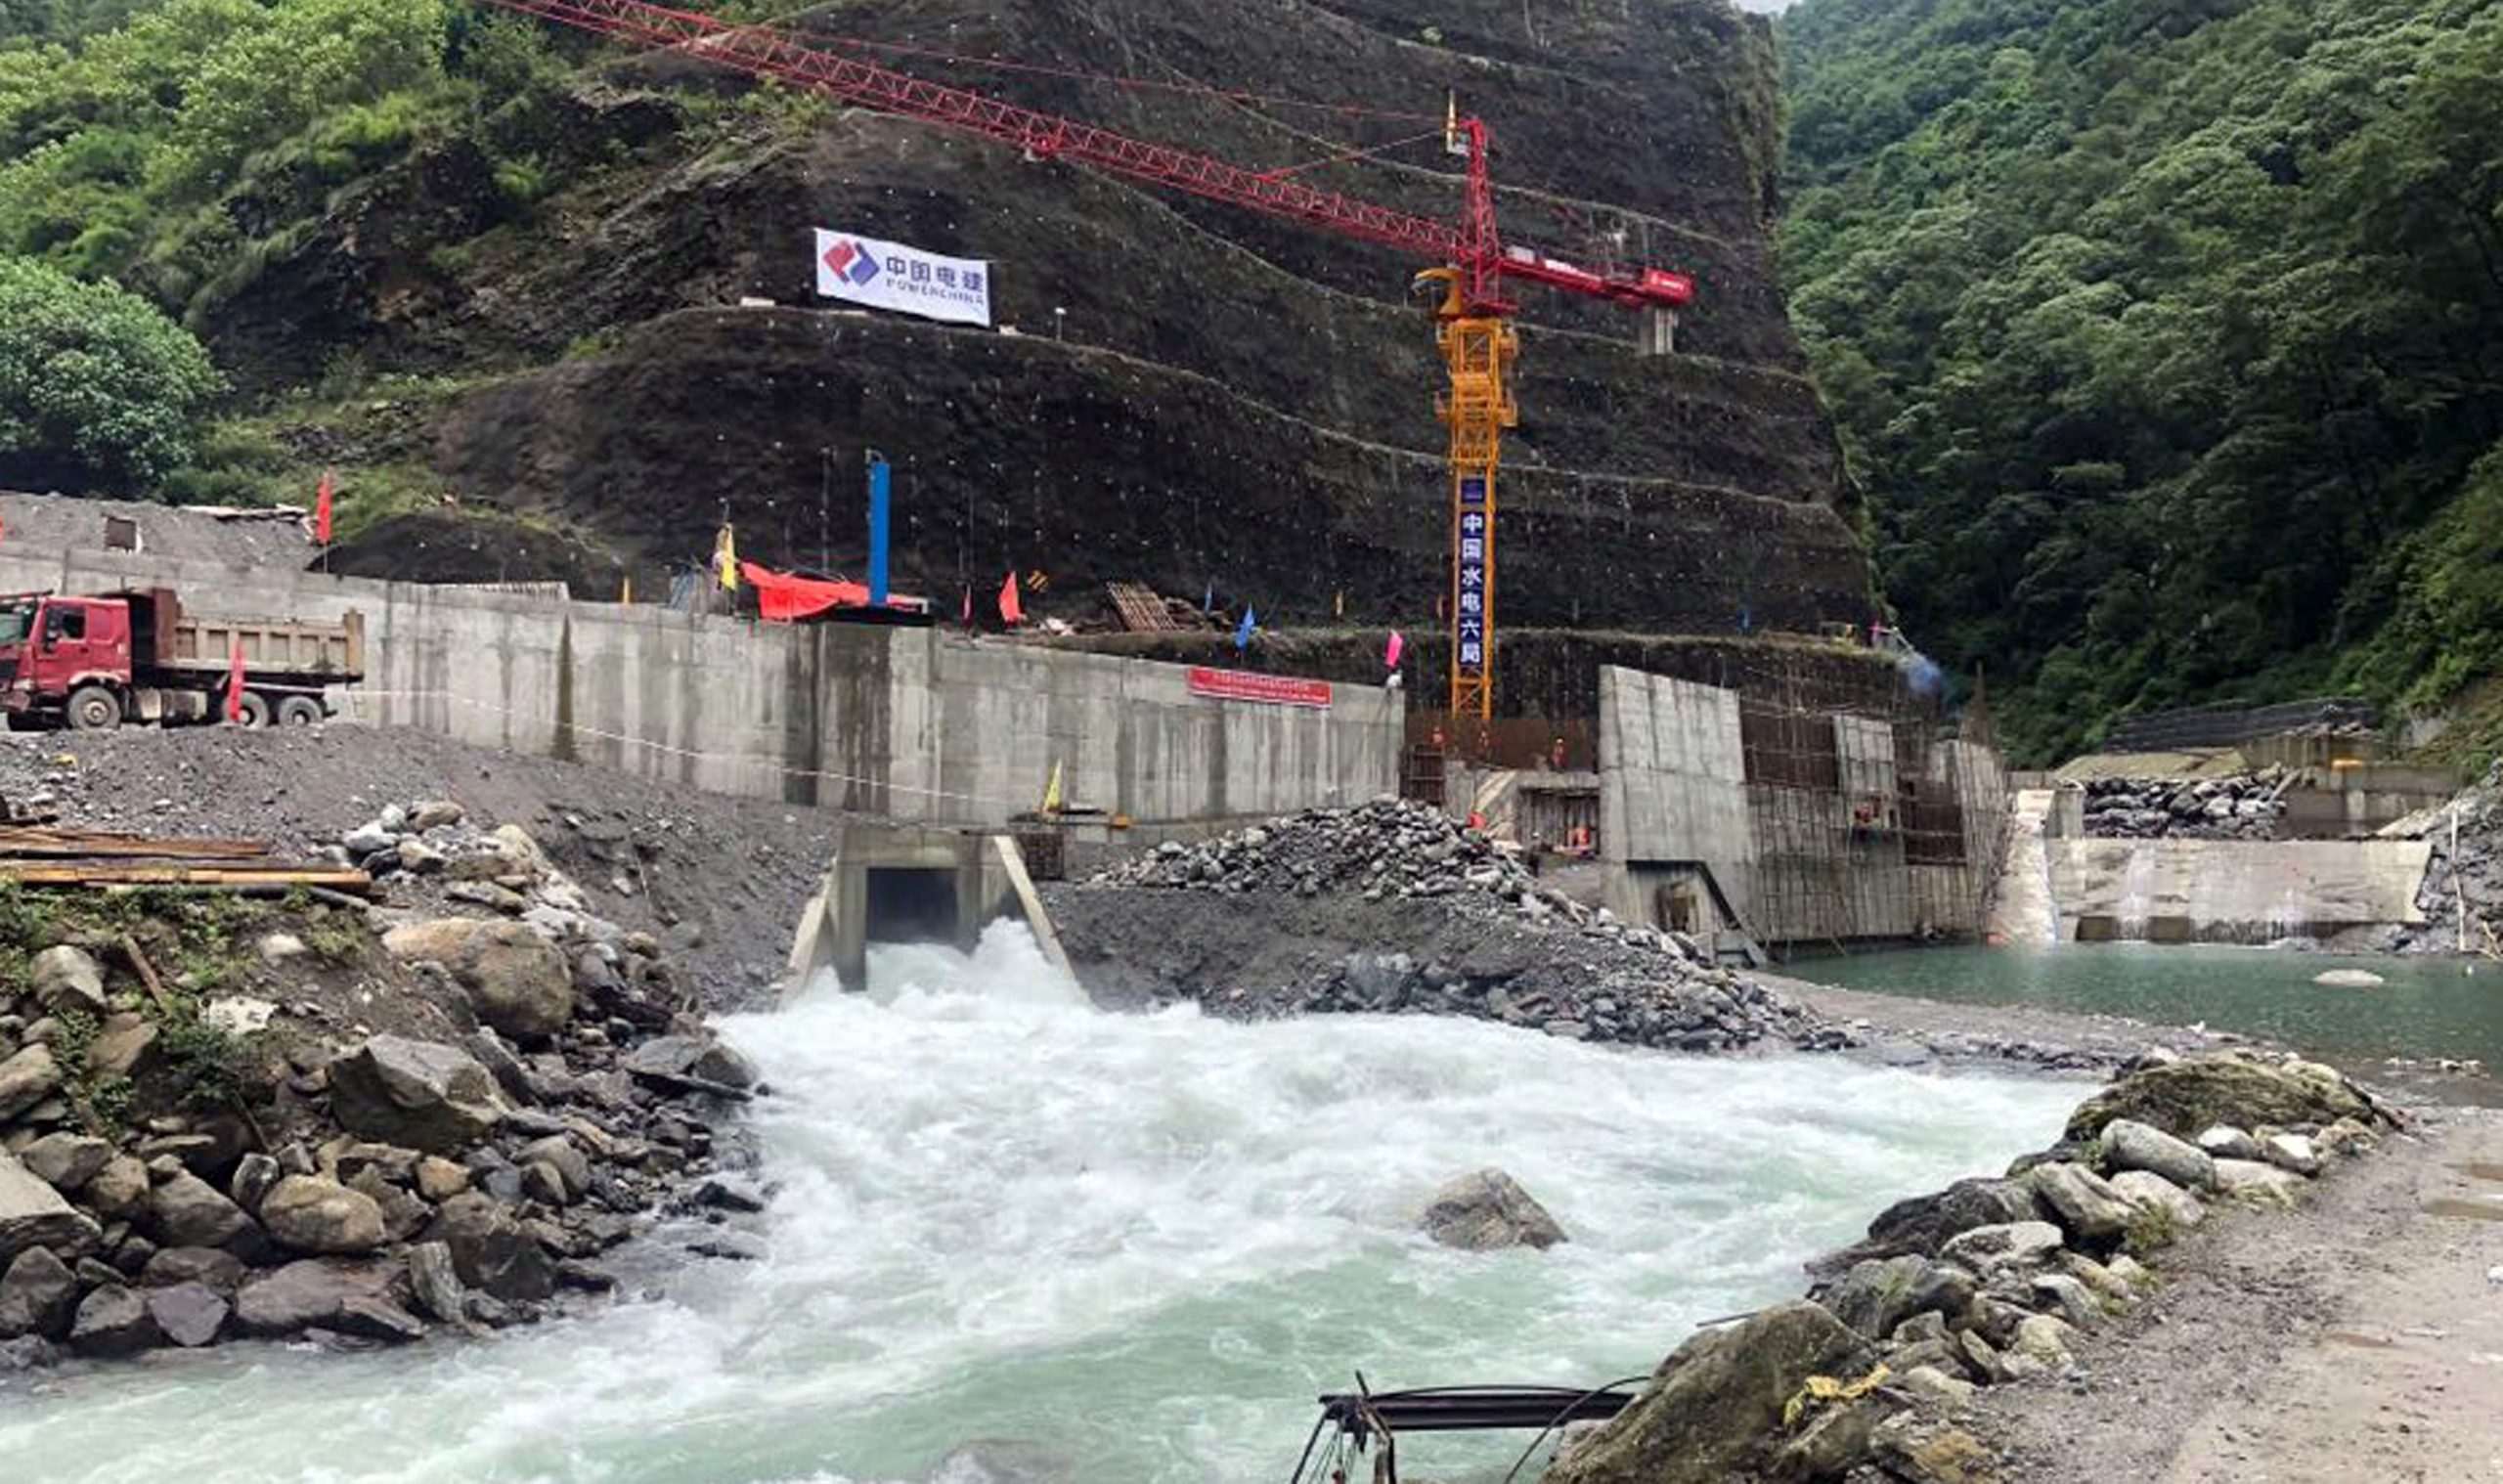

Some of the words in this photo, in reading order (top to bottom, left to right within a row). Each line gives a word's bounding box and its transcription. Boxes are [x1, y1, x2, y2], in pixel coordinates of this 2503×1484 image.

[887, 256, 984, 292] 中国电建
[887, 278, 984, 305] POWERCHINA
[1461, 513, 1483, 663] 中国水电六局
